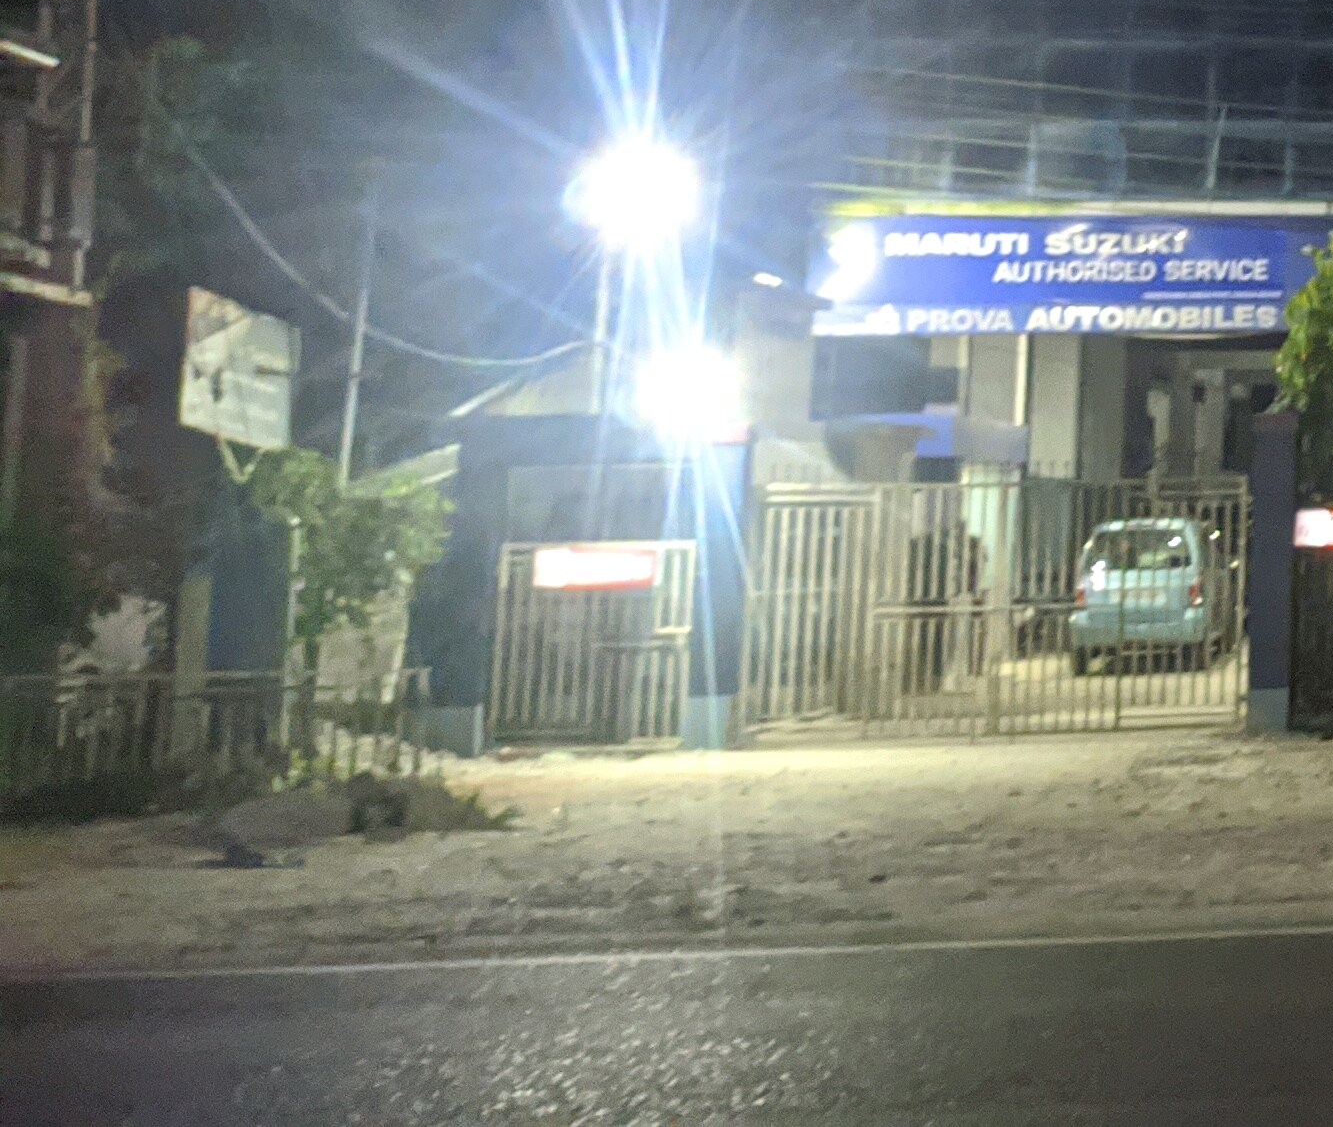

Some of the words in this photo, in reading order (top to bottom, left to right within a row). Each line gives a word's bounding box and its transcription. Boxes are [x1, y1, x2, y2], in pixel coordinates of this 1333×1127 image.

[884, 231, 1030, 257] MARUTI
[1044, 227, 1189, 256] SUZUKI
[991, 259, 1158, 285] AUTHORISED
[1164, 257, 1269, 282] SERVICE
[907, 308, 1015, 334] PROVA
[1027, 304, 1277, 332] AUTOMOBILES
